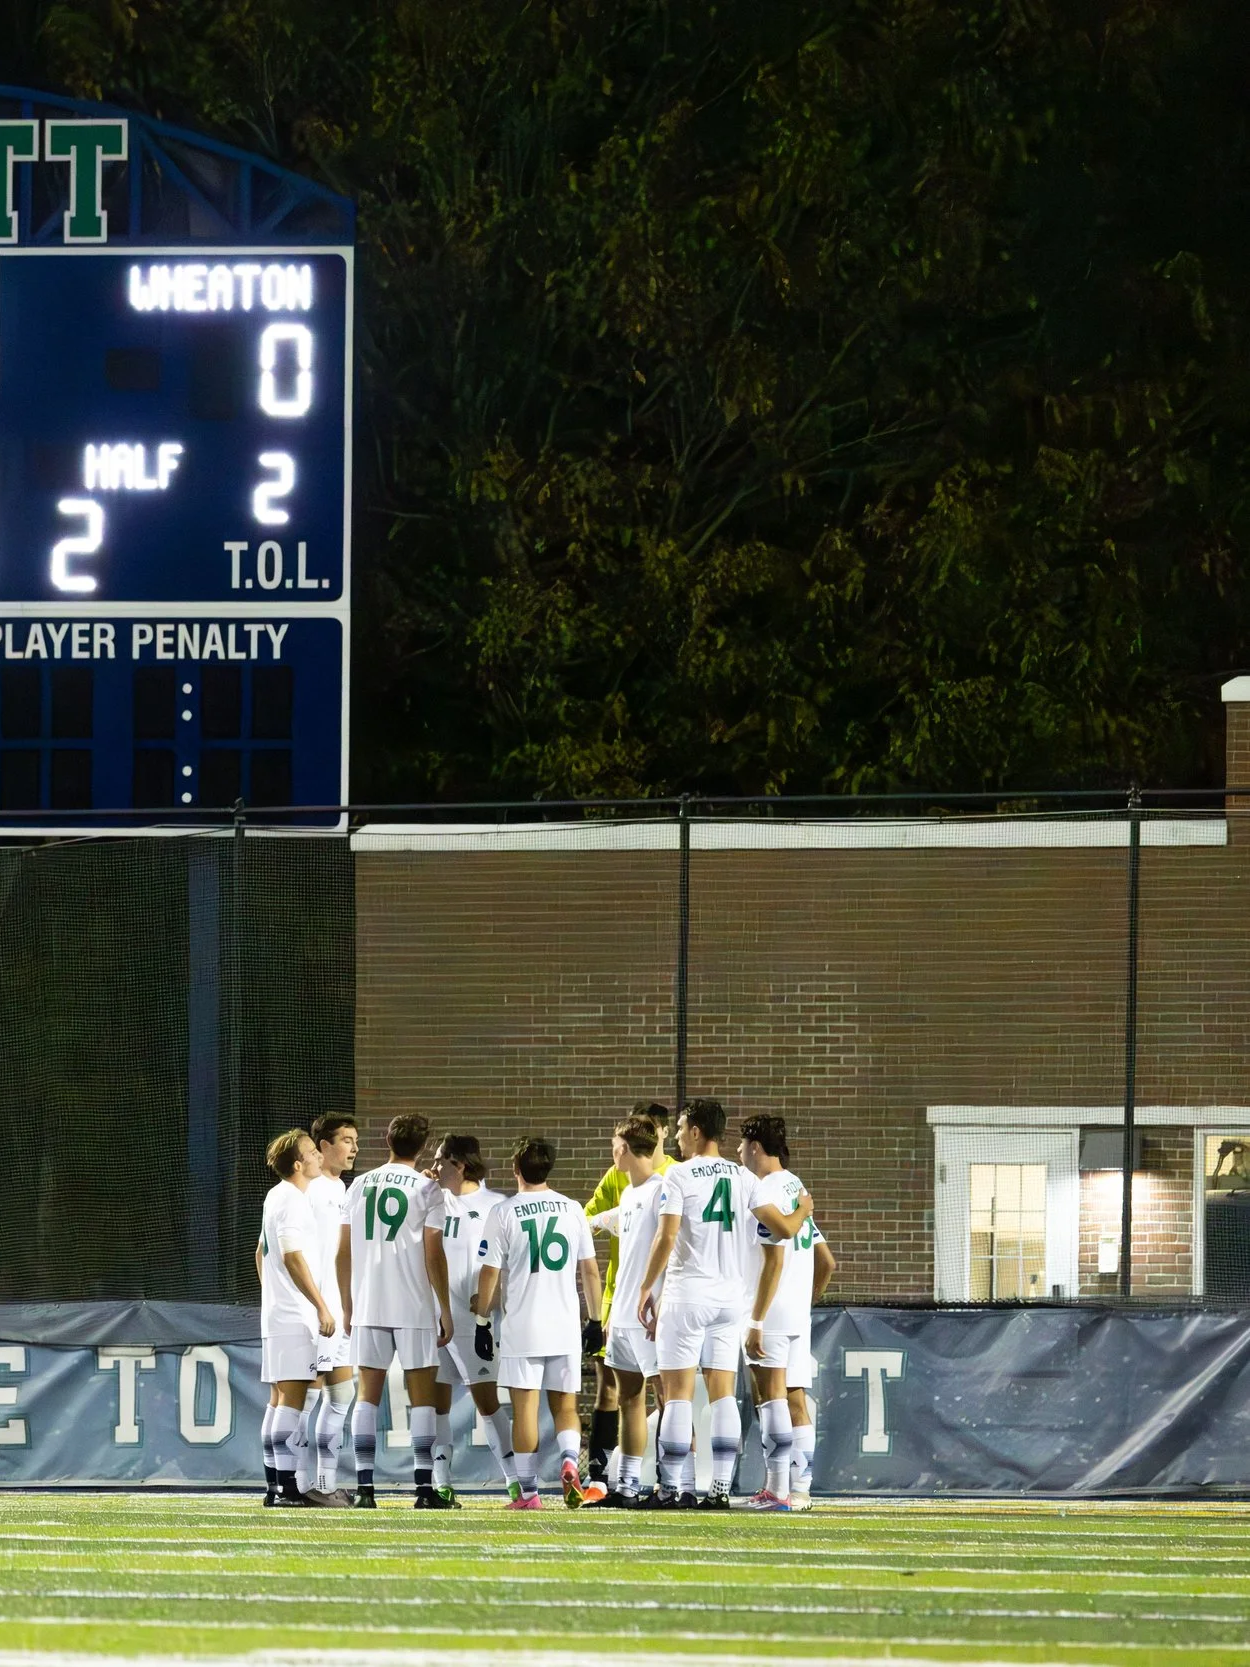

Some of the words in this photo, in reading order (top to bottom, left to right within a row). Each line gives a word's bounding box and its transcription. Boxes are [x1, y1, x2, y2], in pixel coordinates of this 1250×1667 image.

[129, 264, 312, 312] WHEATON
[259, 322, 313, 418] 0
[84, 443, 184, 490] HALF
[252, 452, 296, 525] 2
[50, 497, 105, 593] 2
[223, 541, 330, 589] T.O.L.
[131, 622, 289, 660] PENALTY
[363, 1186, 409, 1242] 19
[443, 1215, 461, 1238] 11
[514, 1200, 569, 1218] ENDICOTT
[702, 1177, 735, 1232] 4
[520, 1216, 569, 1274] 16
[97, 1343, 234, 1447] TO
